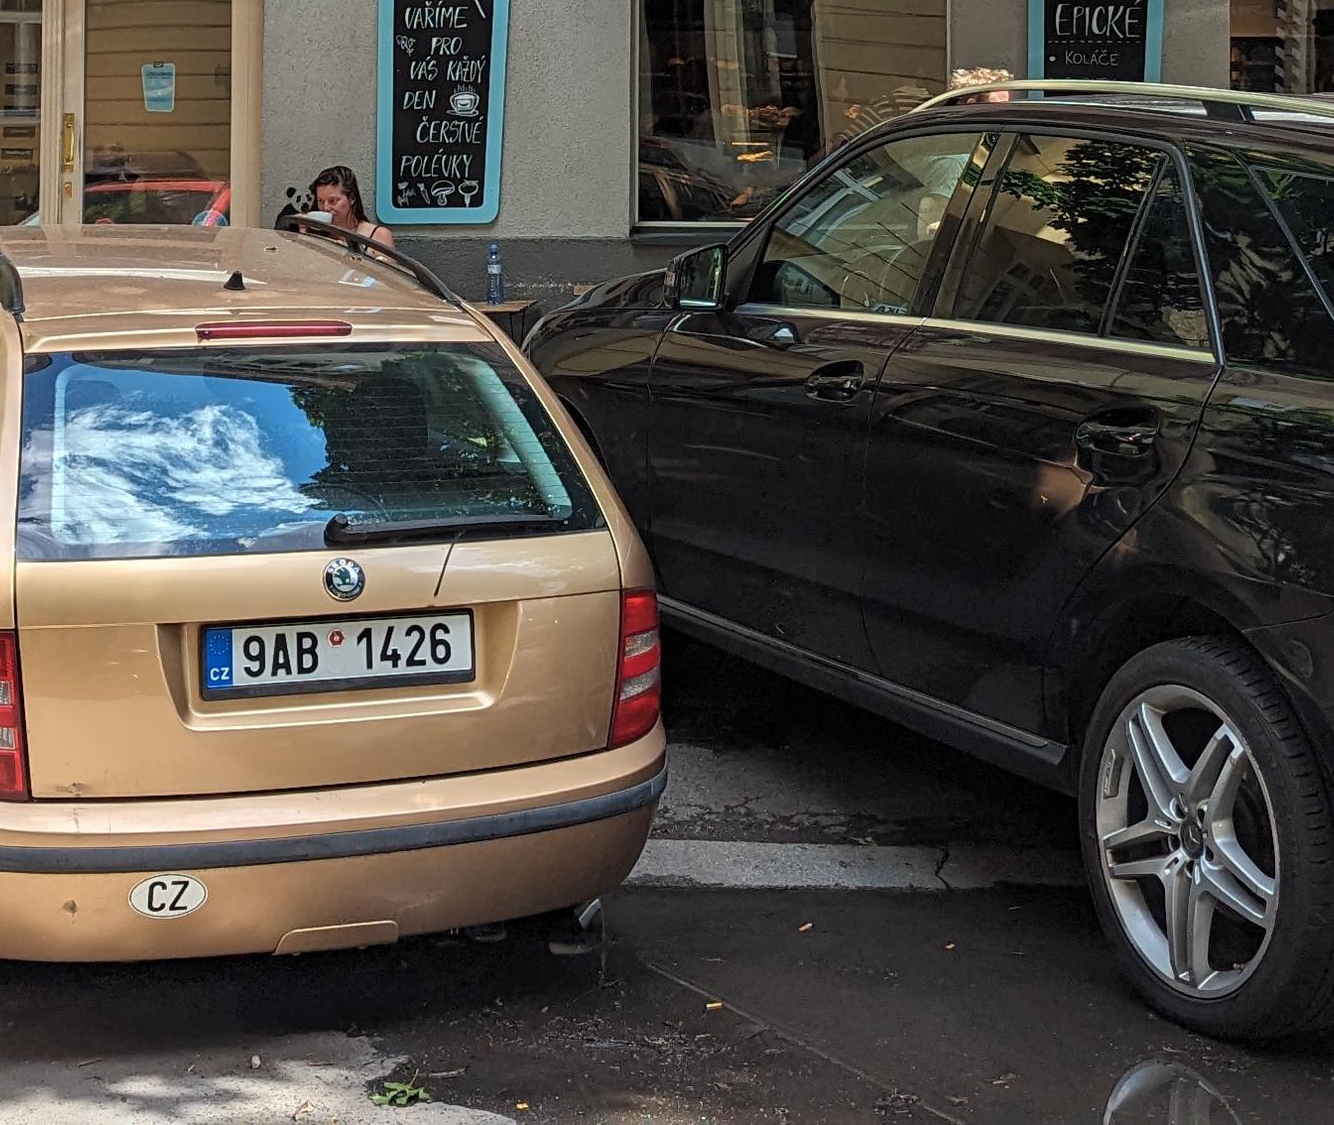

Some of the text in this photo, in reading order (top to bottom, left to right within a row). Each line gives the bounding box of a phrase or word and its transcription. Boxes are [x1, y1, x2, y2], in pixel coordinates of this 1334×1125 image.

[404, 0, 469, 29] VAŘÍME
[430, 36, 463, 55] PRO
[1065, 49, 1119, 66] KOLÁČE
[410, 55, 487, 84] VÁS KAŽDÝ
[403, 90, 437, 110] DEN
[416, 116, 484, 143] ČERSTVÉ
[399, 148, 473, 178] POLÉVKY
[243, 622, 452, 678] 9AB 1426
[210, 667, 230, 681] CZ
[147, 880, 190, 913] CZ
